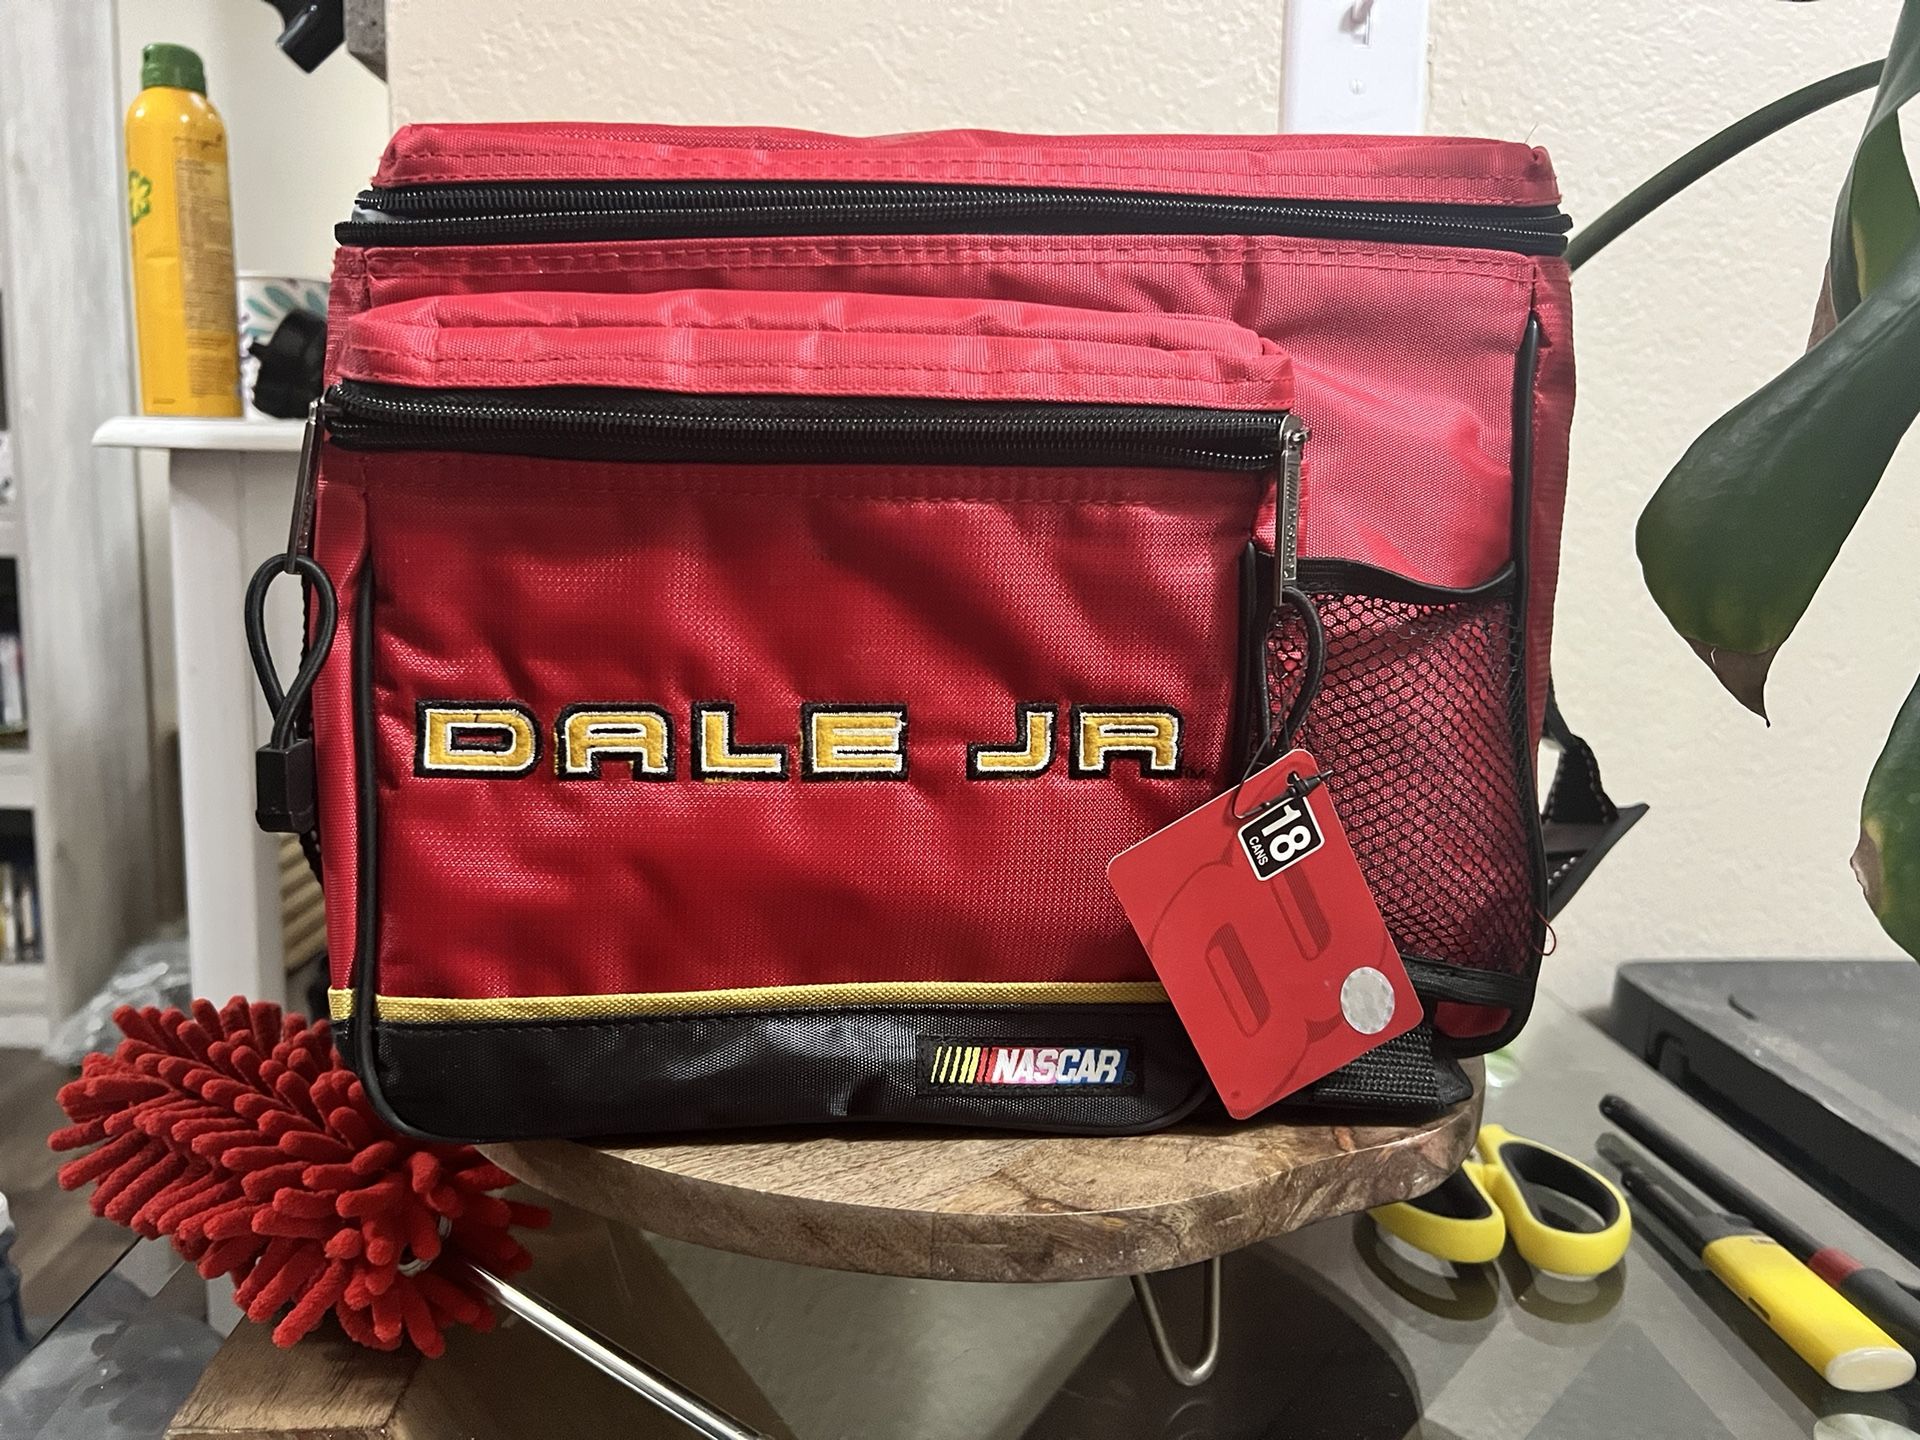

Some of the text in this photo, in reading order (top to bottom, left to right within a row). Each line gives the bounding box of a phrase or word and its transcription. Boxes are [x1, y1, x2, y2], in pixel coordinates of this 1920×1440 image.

[414, 699, 908, 780] DALE
[967, 703, 1182, 780] JR
[1249, 836, 1269, 866] CANS
[1261, 804, 1312, 862] 18
[991, 1048, 1122, 1084] NASCAR
